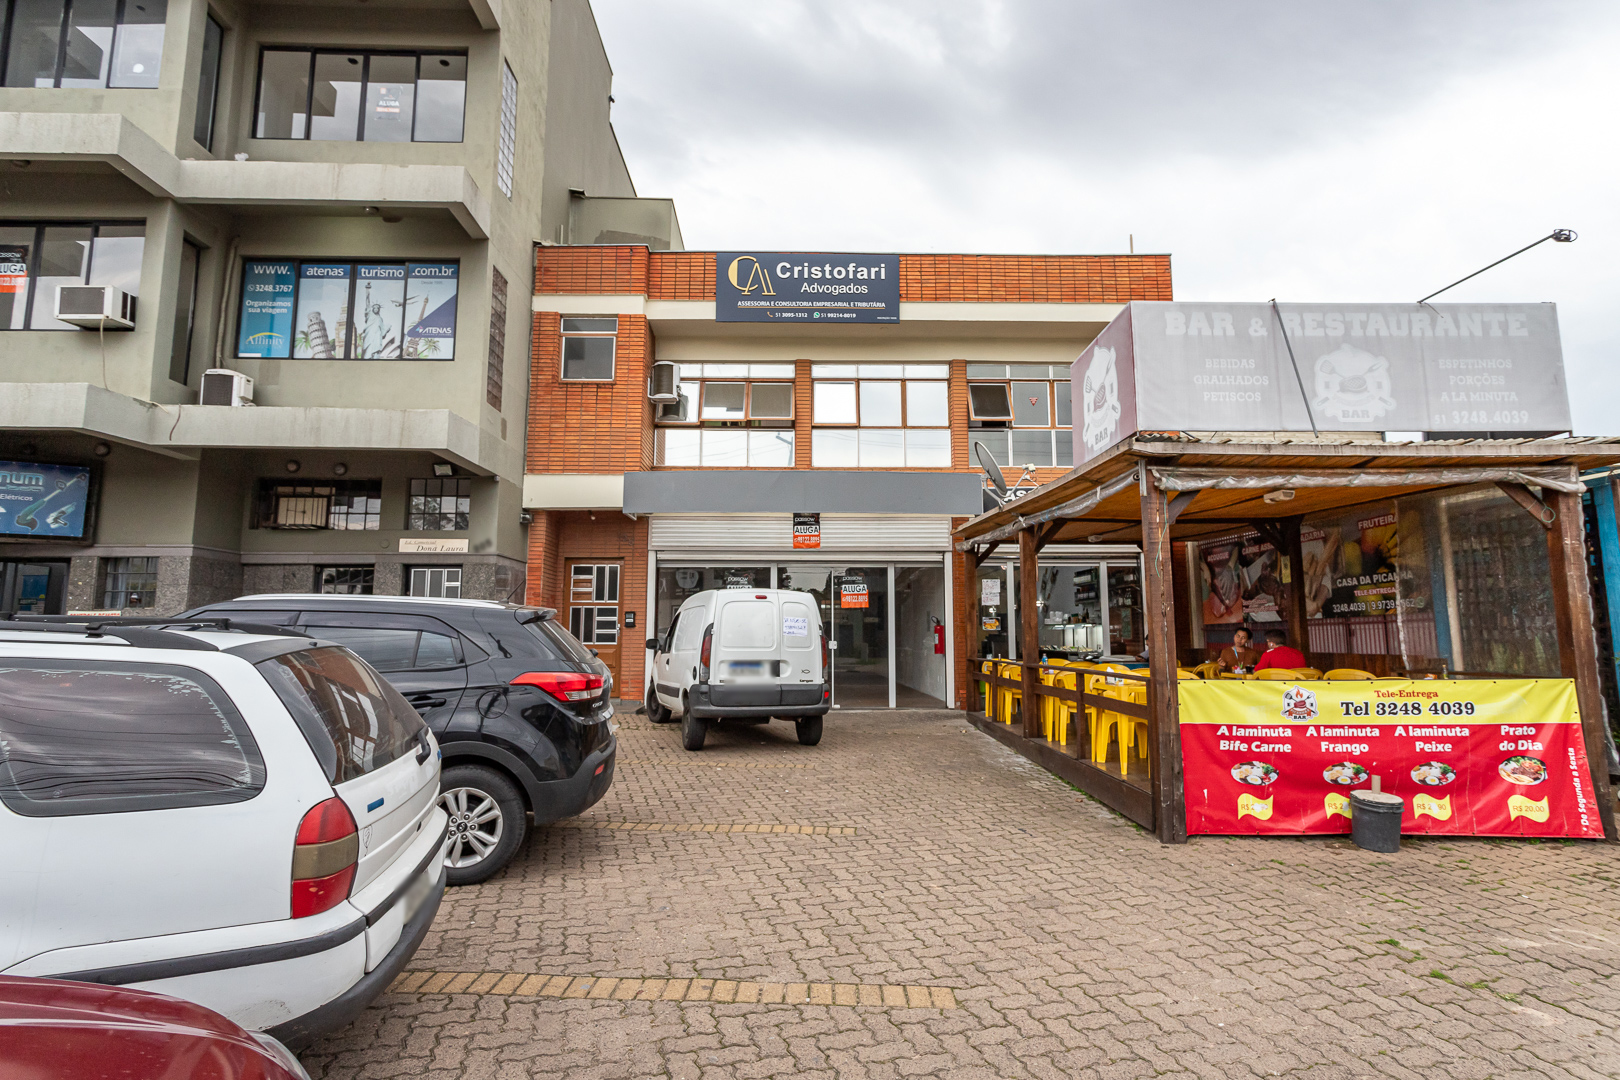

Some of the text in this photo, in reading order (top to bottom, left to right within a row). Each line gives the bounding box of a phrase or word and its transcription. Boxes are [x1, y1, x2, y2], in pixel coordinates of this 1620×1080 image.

[0, 264, 25, 274] LUGA
[254, 265, 454, 277] www. atenas turismo .com.br
[776, 262, 886, 280] Cristofari
[801, 283, 868, 296] Advogados
[1164, 312, 1528, 336] BAR & RESTAURANTE
[1205, 358, 1256, 368] BEBIDAS
[1438, 359, 1512, 369] ESPETINHOS
[1194, 375, 1269, 386] GRALHADOS
[1450, 373, 1505, 387] PORÇÕES
[1203, 392, 1262, 402] PETISCOS
[1440, 392, 1518, 401] A LA MINUTA
[1342, 410, 1370, 418] BAR
[1435, 410, 1528, 424] 51 3248.4039
[1095, 427, 1108, 445] BAR
[0, 472, 43, 485] num
[1300, 530, 1325, 541] ADARIA
[1337, 576, 1358, 587] CASA
[1360, 575, 1372, 585] DA
[1354, 587, 1396, 597] TELE-ENTREGA
[1333, 602, 1366, 612] 3248.4039
[1374, 690, 1438, 699] Tele-Entrega
[1341, 702, 1475, 716] Tel 3248 4039
[1217, 726, 1292, 737] A laminuta
[1306, 726, 1380, 736] A laminuta
[1394, 726, 1469, 736] A laminuta
[1501, 725, 1536, 736] Prato
[1220, 740, 1291, 752] Bife Carne
[1321, 742, 1369, 755] Frango
[1416, 741, 1452, 752] Peixe
[1499, 740, 1543, 750] do Dia
[1568, 748, 1578, 770] Sexta
[1573, 778, 1586, 812] Segunda
[1581, 814, 1589, 826] De
